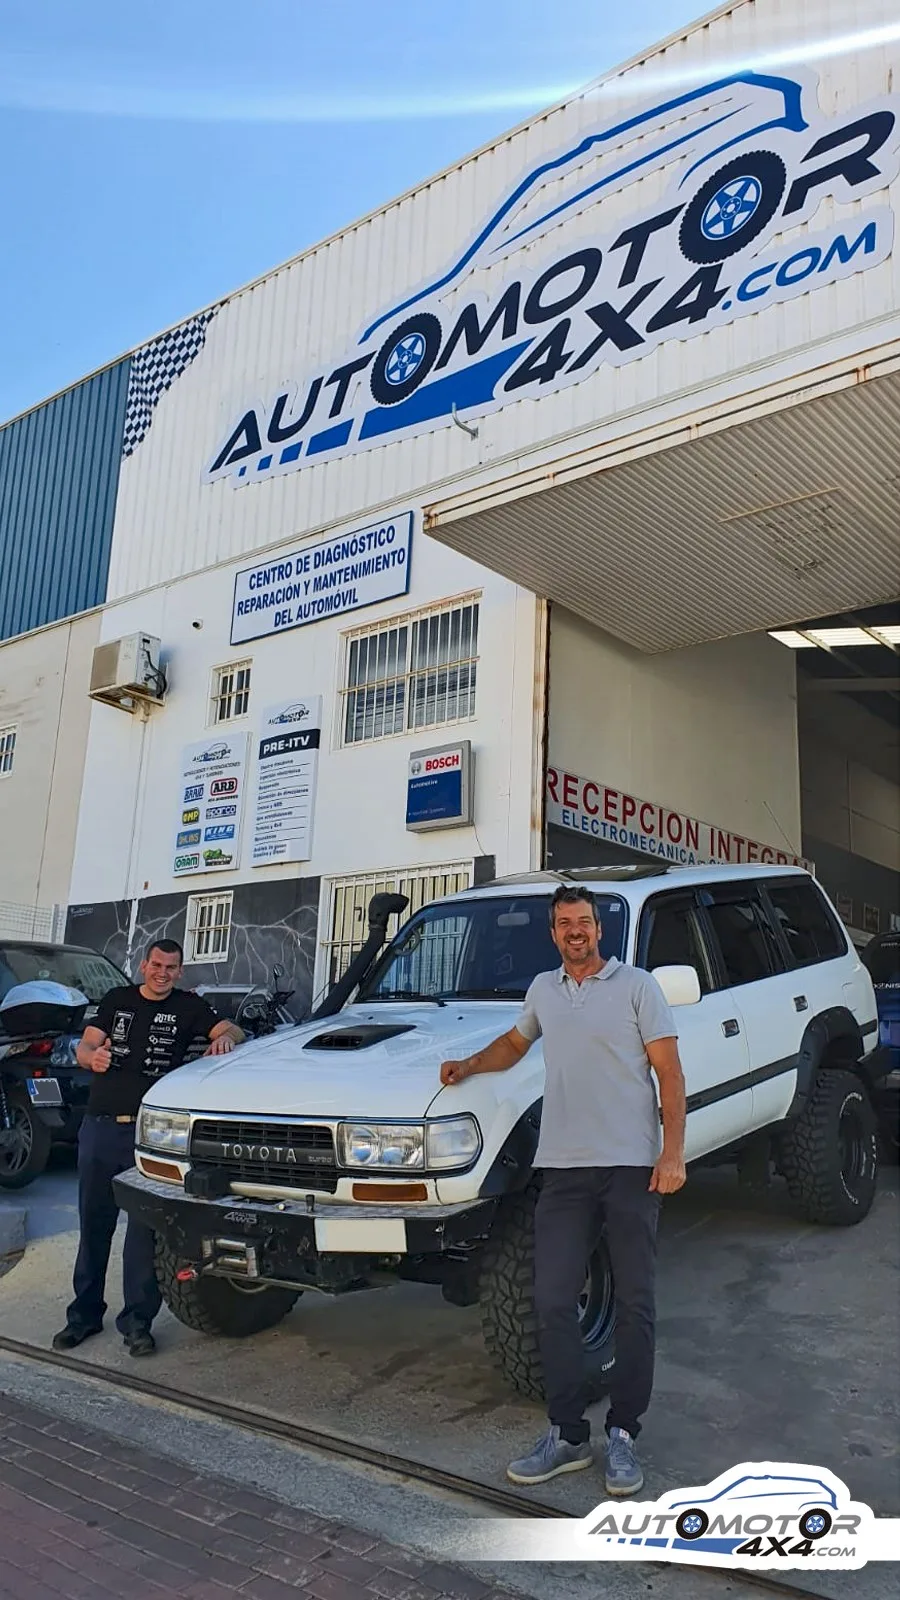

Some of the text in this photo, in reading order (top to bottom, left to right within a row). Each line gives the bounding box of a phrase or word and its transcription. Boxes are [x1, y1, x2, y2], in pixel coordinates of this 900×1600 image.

[209, 110, 896, 472] AUTOMOTOR
[249, 525, 395, 590] CENTRO DE DIAGNÓSTICO
[237, 547, 406, 617] REPARACIÓN Y MANTENIMIENTO
[274, 588, 358, 628] DEL AUTOMÓVIL
[263, 735, 310, 755] PRE-ITV
[425, 754, 460, 771] BOSCH
[213, 781, 235, 793] ARB
[547, 767, 699, 851] RECEPCION
[206, 825, 234, 836] KING
[562, 809, 696, 865] ELECTROMECANICA
[221, 1142, 297, 1163] TOYOTA
